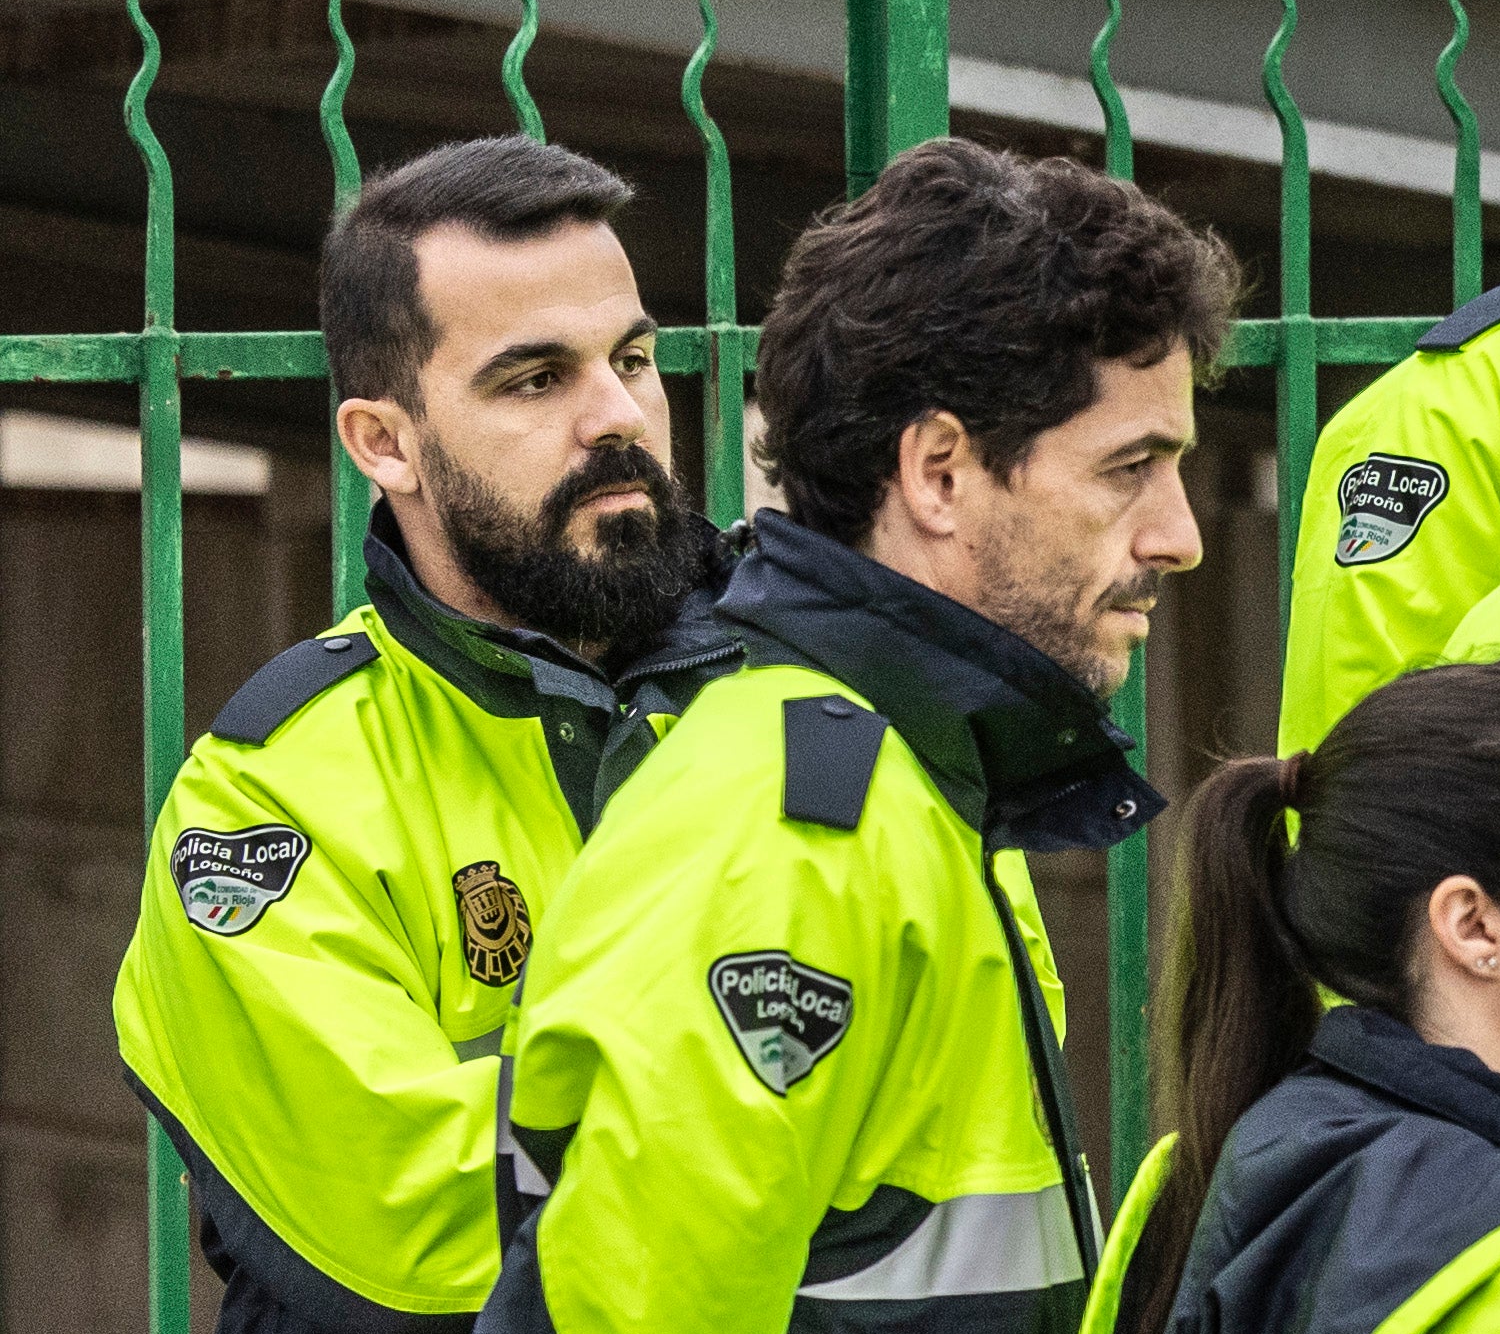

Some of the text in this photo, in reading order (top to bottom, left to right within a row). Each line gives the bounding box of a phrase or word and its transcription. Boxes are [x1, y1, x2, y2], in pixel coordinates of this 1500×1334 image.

[1388, 470, 1437, 497] Local
[1349, 493, 1403, 513] ogroño
[1366, 531, 1389, 546] Rioja
[172, 838, 298, 872] Policía Local
[189, 860, 264, 881] Logroño
[216, 895, 256, 907] La Rioja
